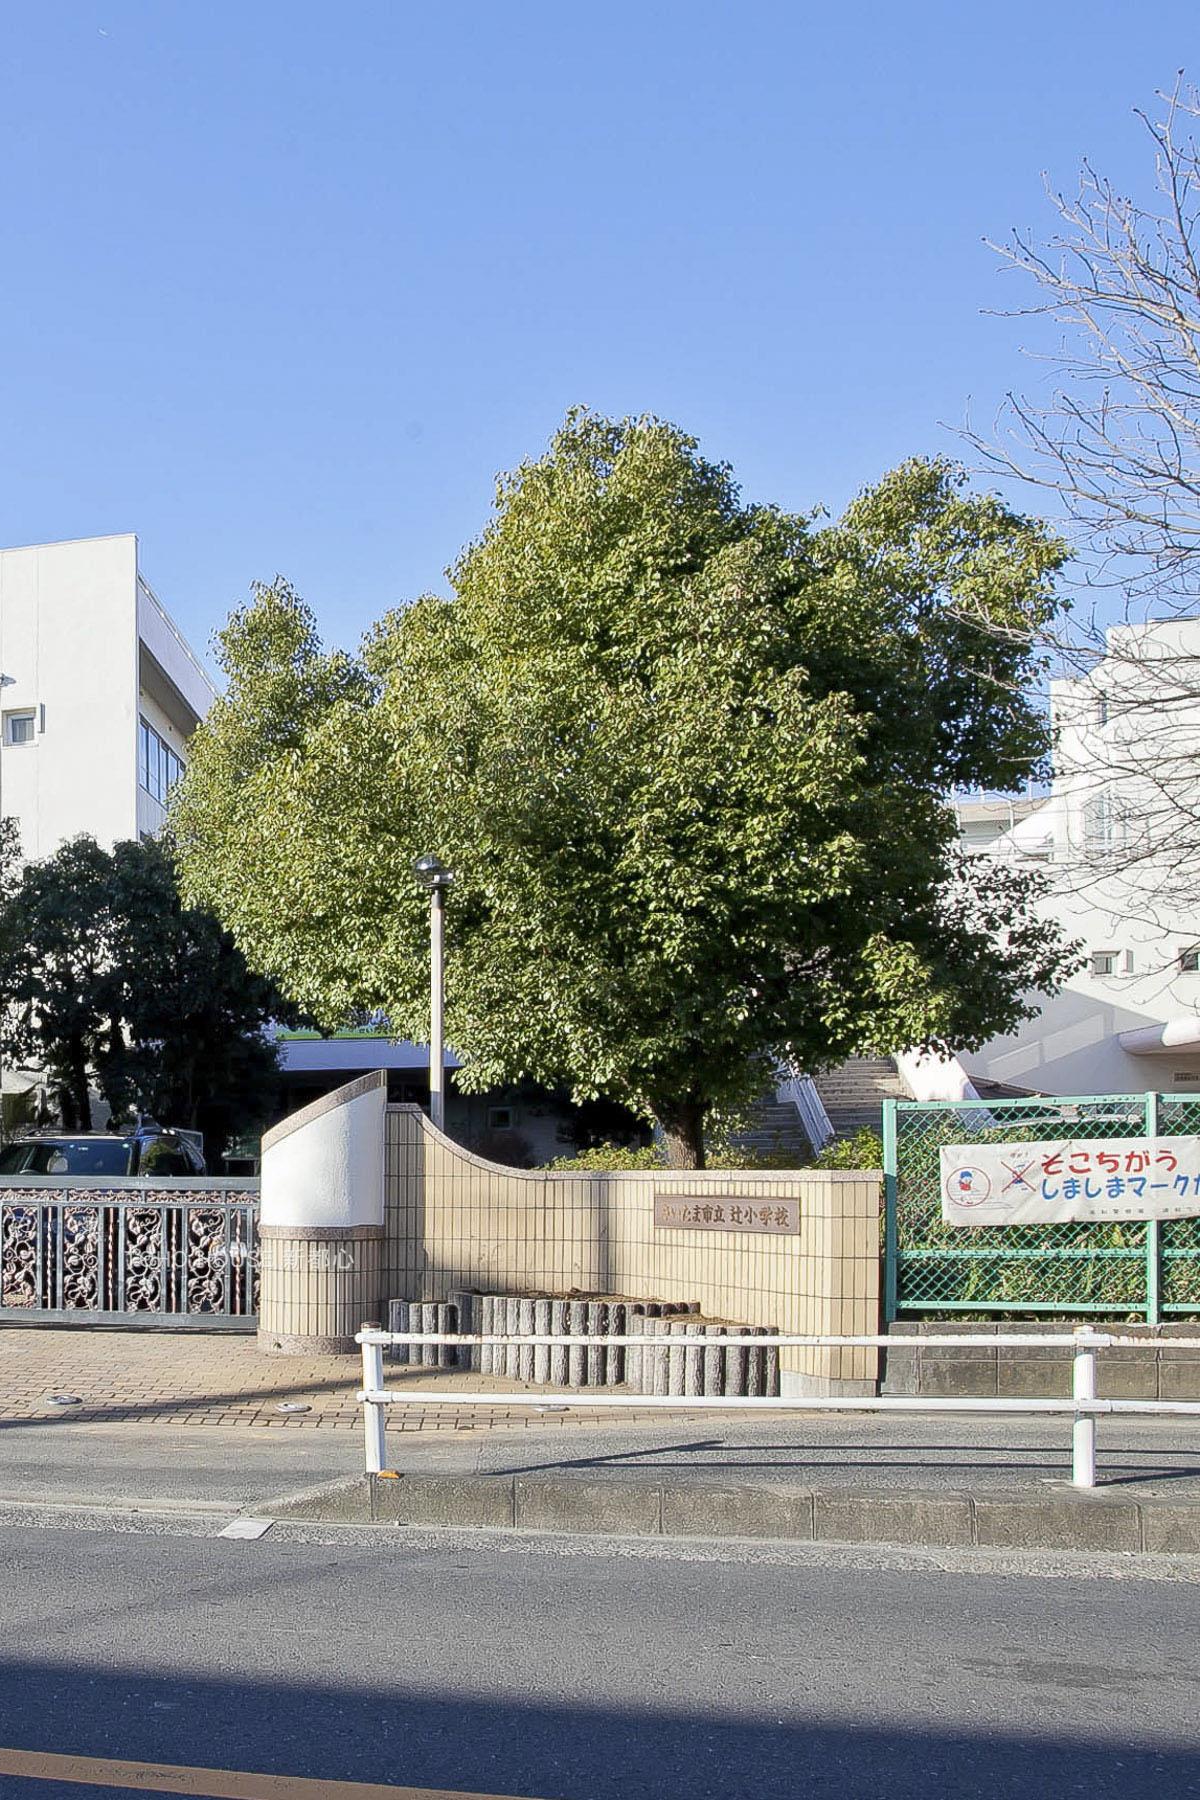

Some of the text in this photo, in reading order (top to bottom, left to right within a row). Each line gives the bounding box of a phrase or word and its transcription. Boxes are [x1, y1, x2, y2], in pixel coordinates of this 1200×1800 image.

[1041, 1149, 1178, 1175] そこちがう
